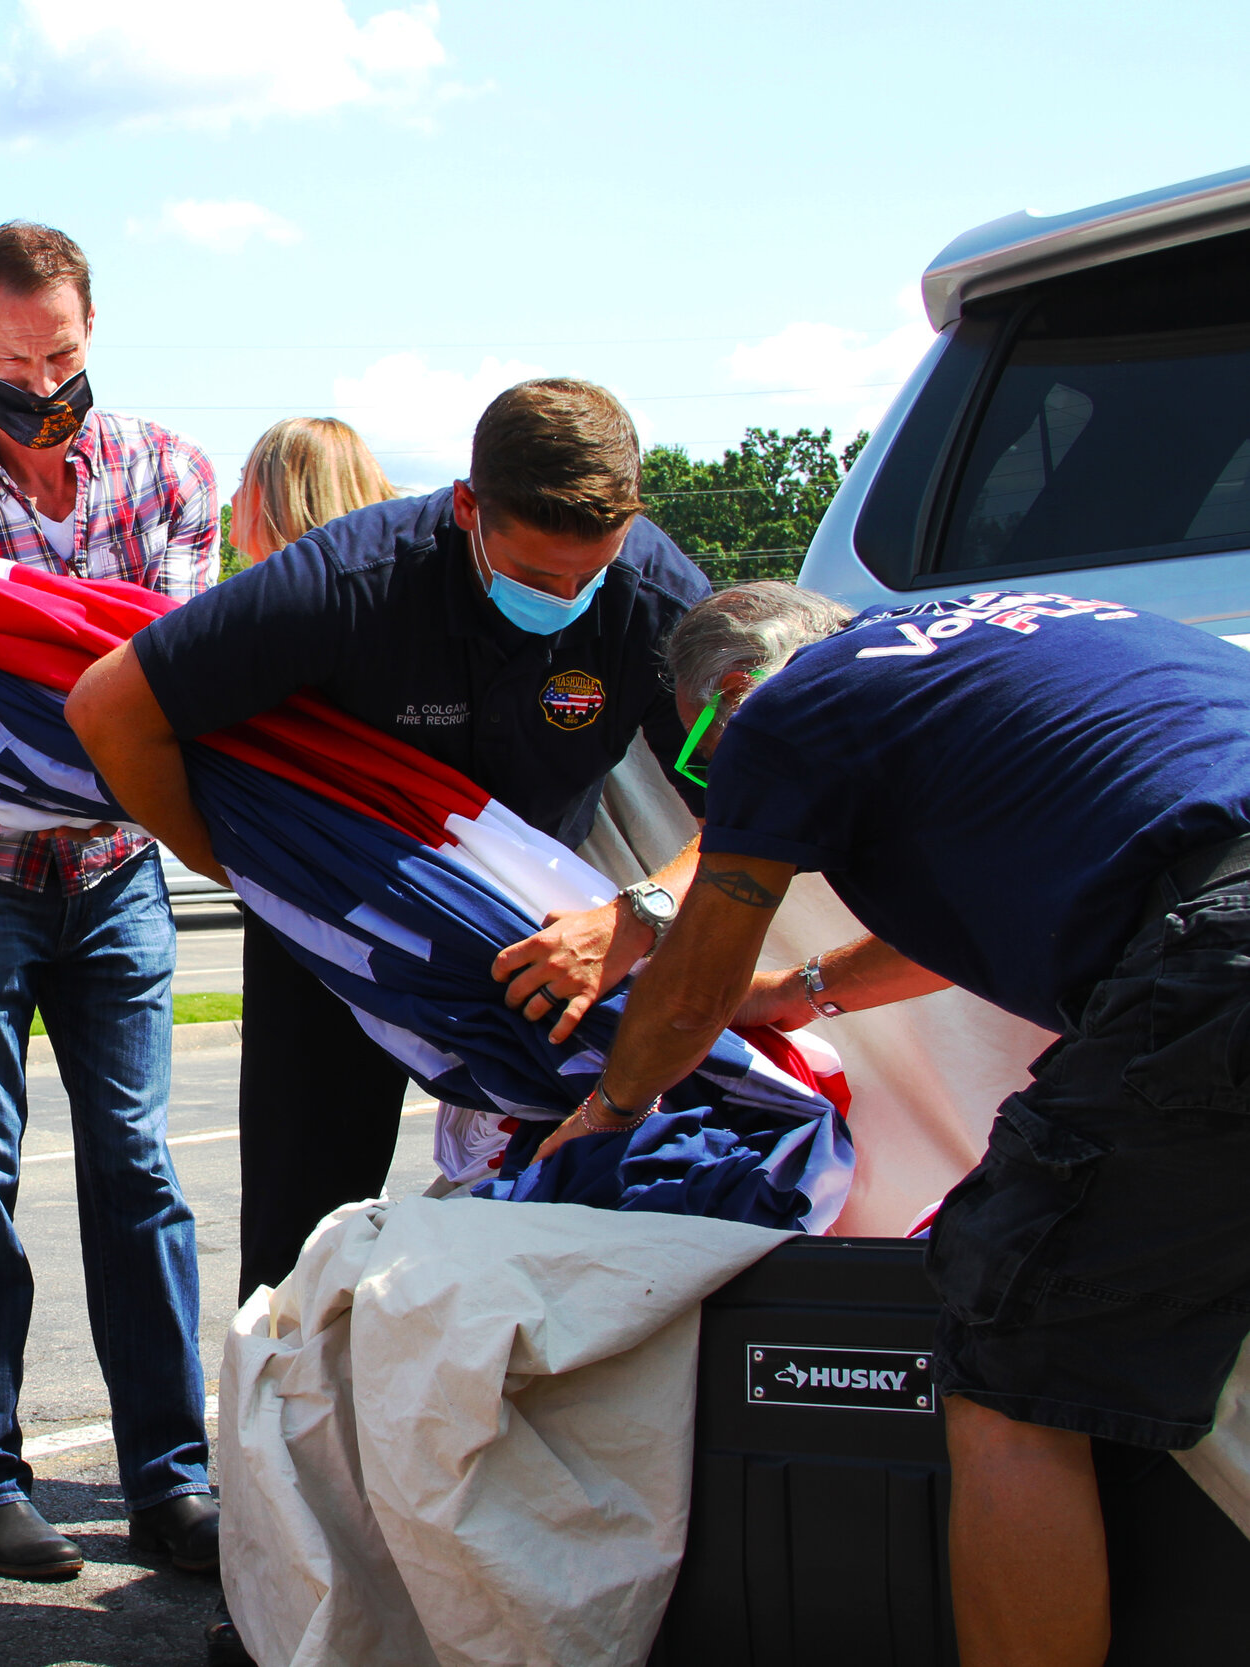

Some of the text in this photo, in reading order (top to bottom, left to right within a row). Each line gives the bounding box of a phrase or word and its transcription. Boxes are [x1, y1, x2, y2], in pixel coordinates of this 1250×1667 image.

[406, 702, 467, 715] R. COLGAN
[396, 712, 471, 725] FIRE RECRUIT
[810, 1367, 907, 1391] HUSKY
